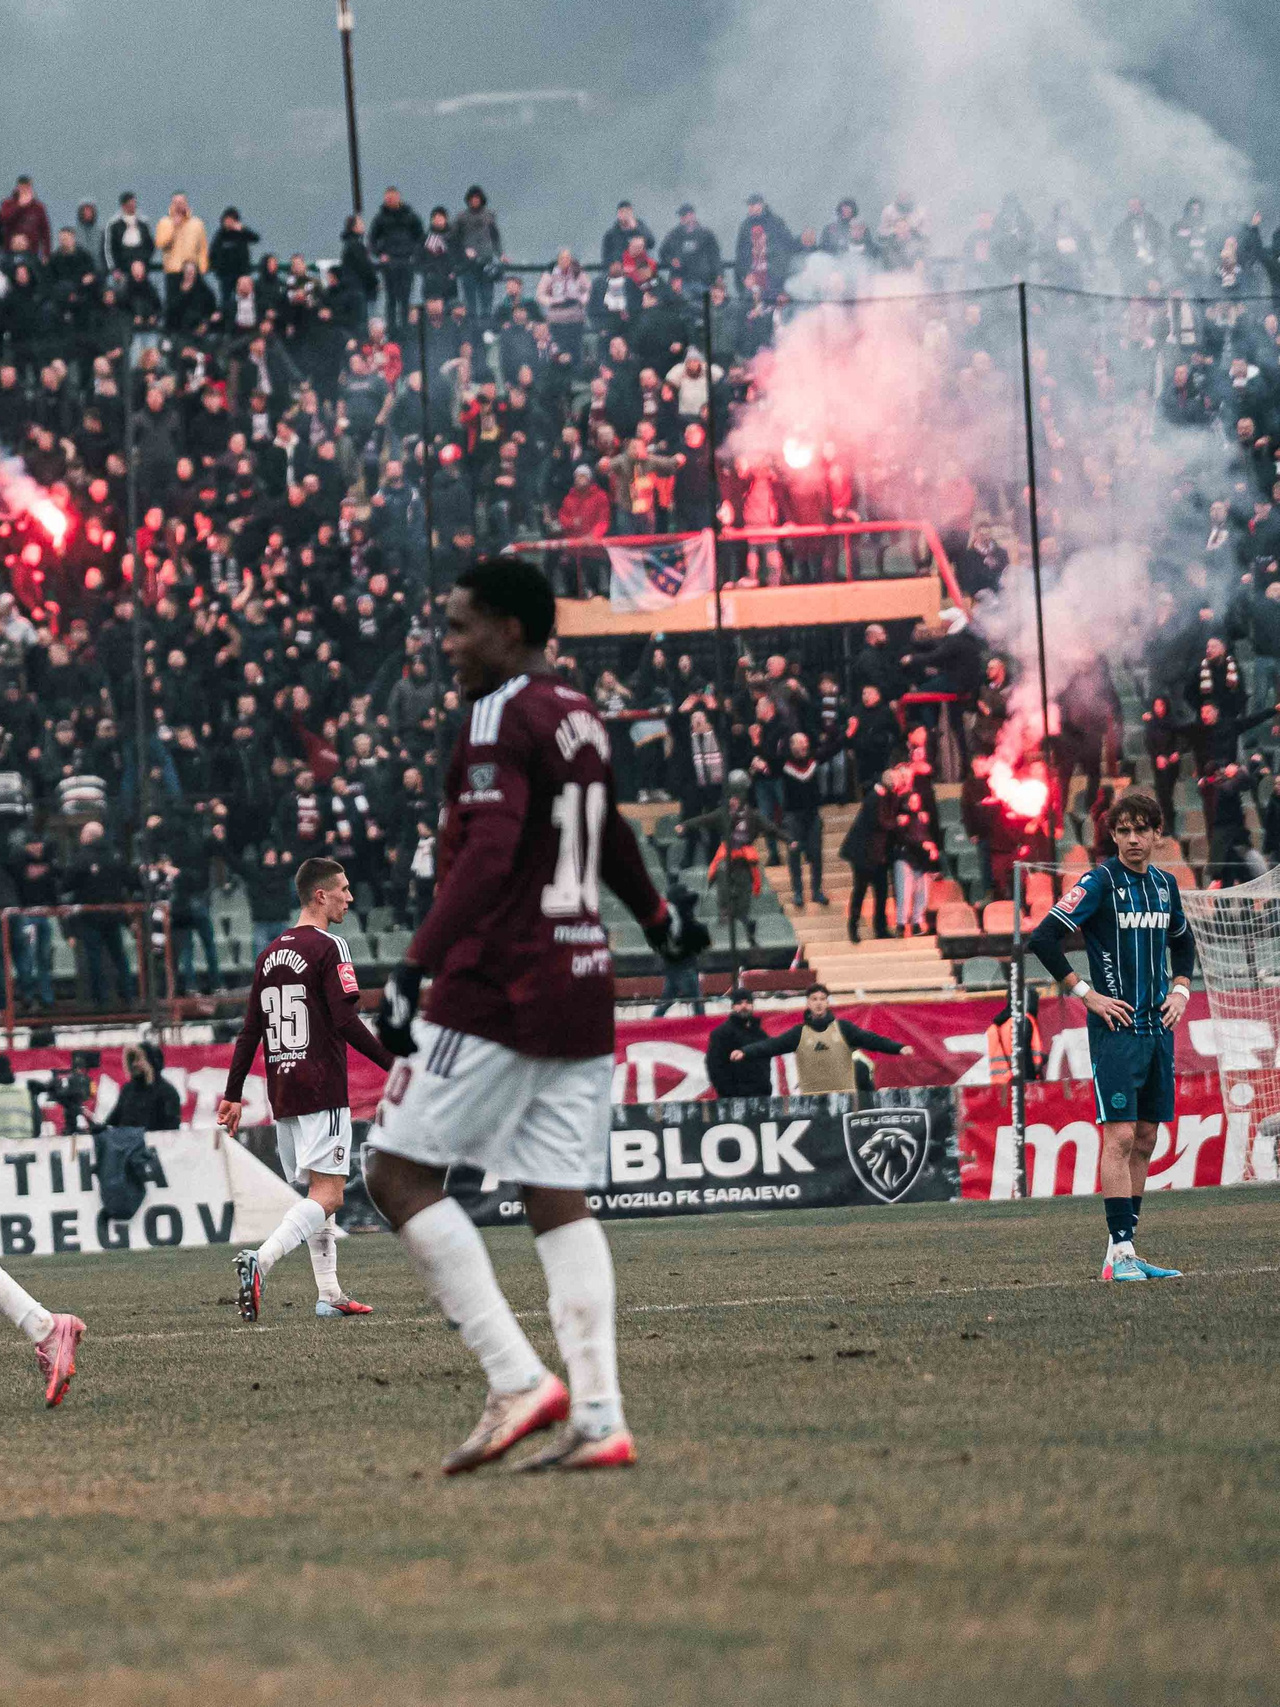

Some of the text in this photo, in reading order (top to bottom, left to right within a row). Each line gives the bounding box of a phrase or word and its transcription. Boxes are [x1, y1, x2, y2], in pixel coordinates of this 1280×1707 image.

[261, 984, 310, 1053] 35
[850, 1114, 921, 1128] PEUGEOT
[609, 1119, 816, 1184] BLOK
[605, 1190, 674, 1211] VOZILO
[675, 1189, 701, 1205] FK
[703, 1184, 801, 1203] SARAJEVO
